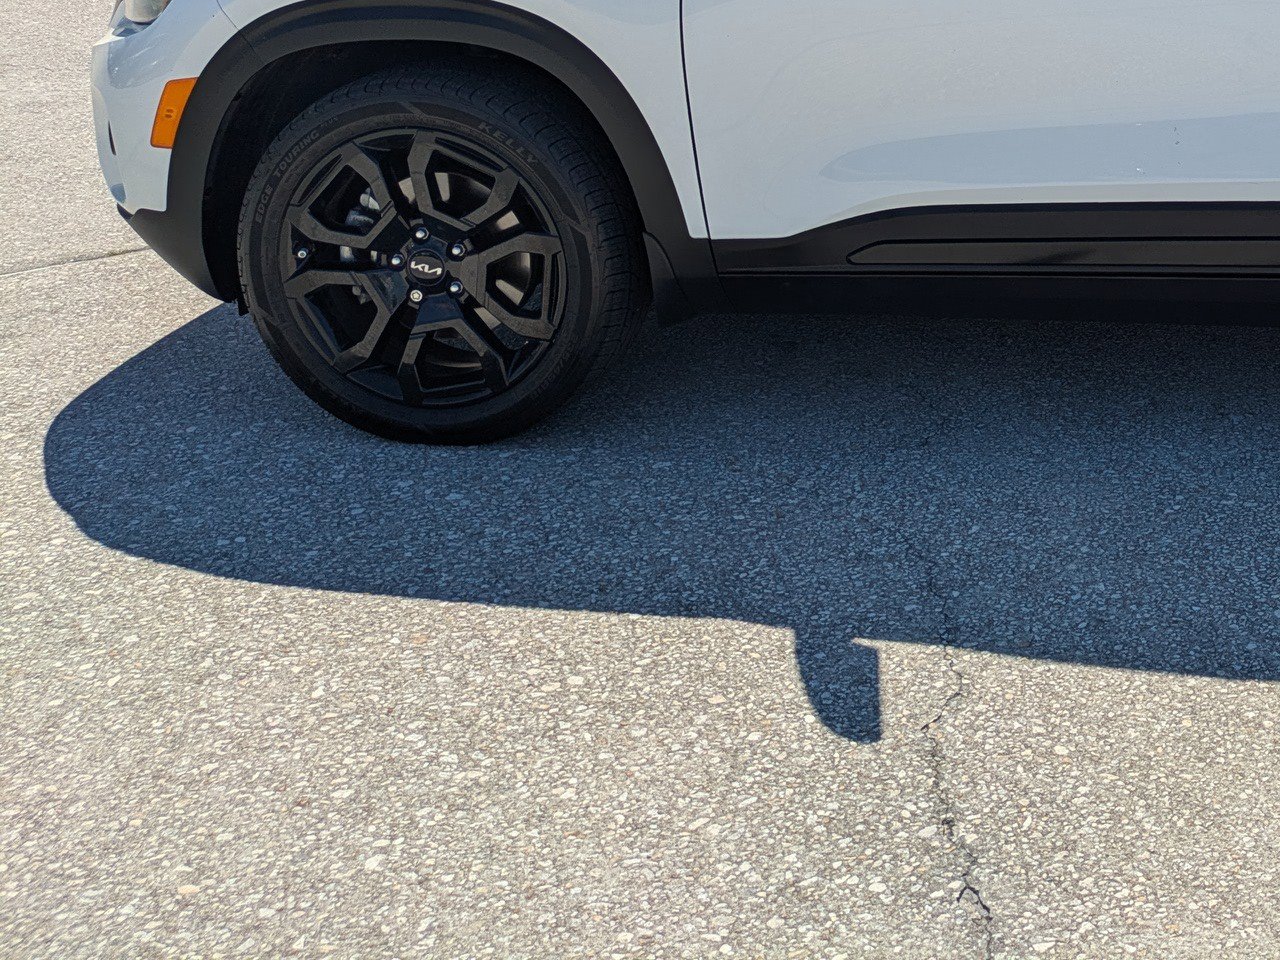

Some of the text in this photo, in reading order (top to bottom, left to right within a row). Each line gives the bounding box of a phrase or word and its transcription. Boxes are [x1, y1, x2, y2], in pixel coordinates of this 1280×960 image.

[255, 184, 274, 223] EDGE
[273, 130, 320, 178] TOURING
[478, 122, 538, 164] KELLY
